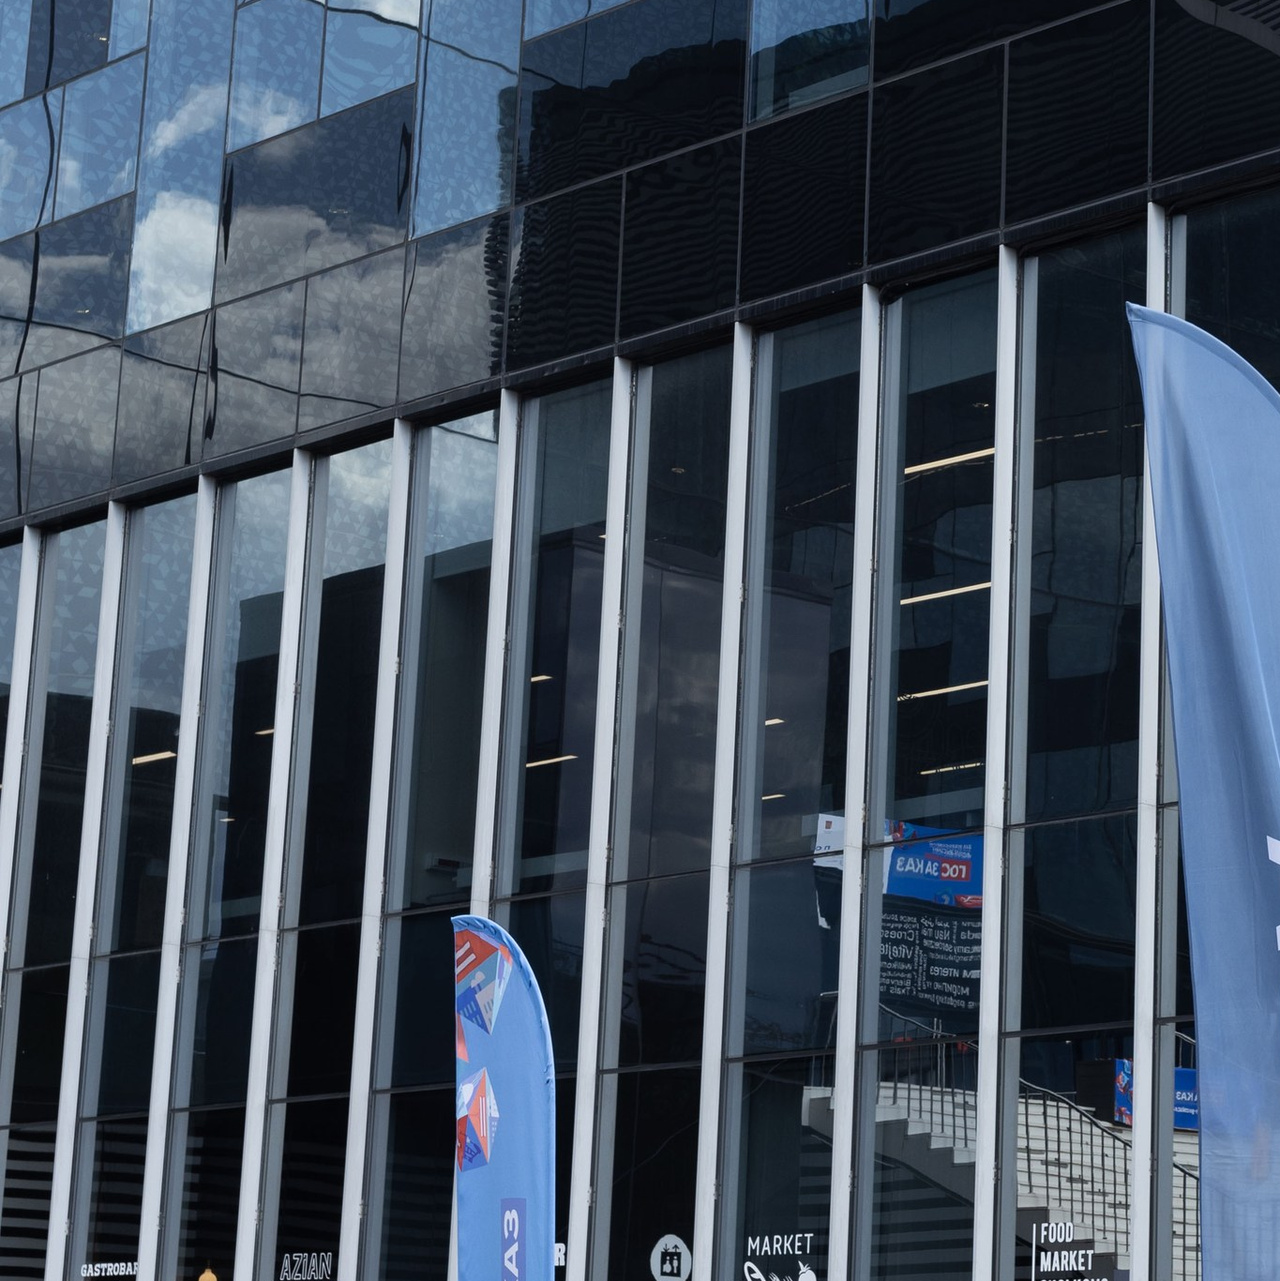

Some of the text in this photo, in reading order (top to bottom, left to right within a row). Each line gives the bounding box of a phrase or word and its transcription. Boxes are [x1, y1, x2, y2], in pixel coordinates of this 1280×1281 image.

[1040, 1222, 1075, 1244] FOOD
[747, 1233, 814, 1256] MARKET
[1040, 1250, 1094, 1272] MARKET
